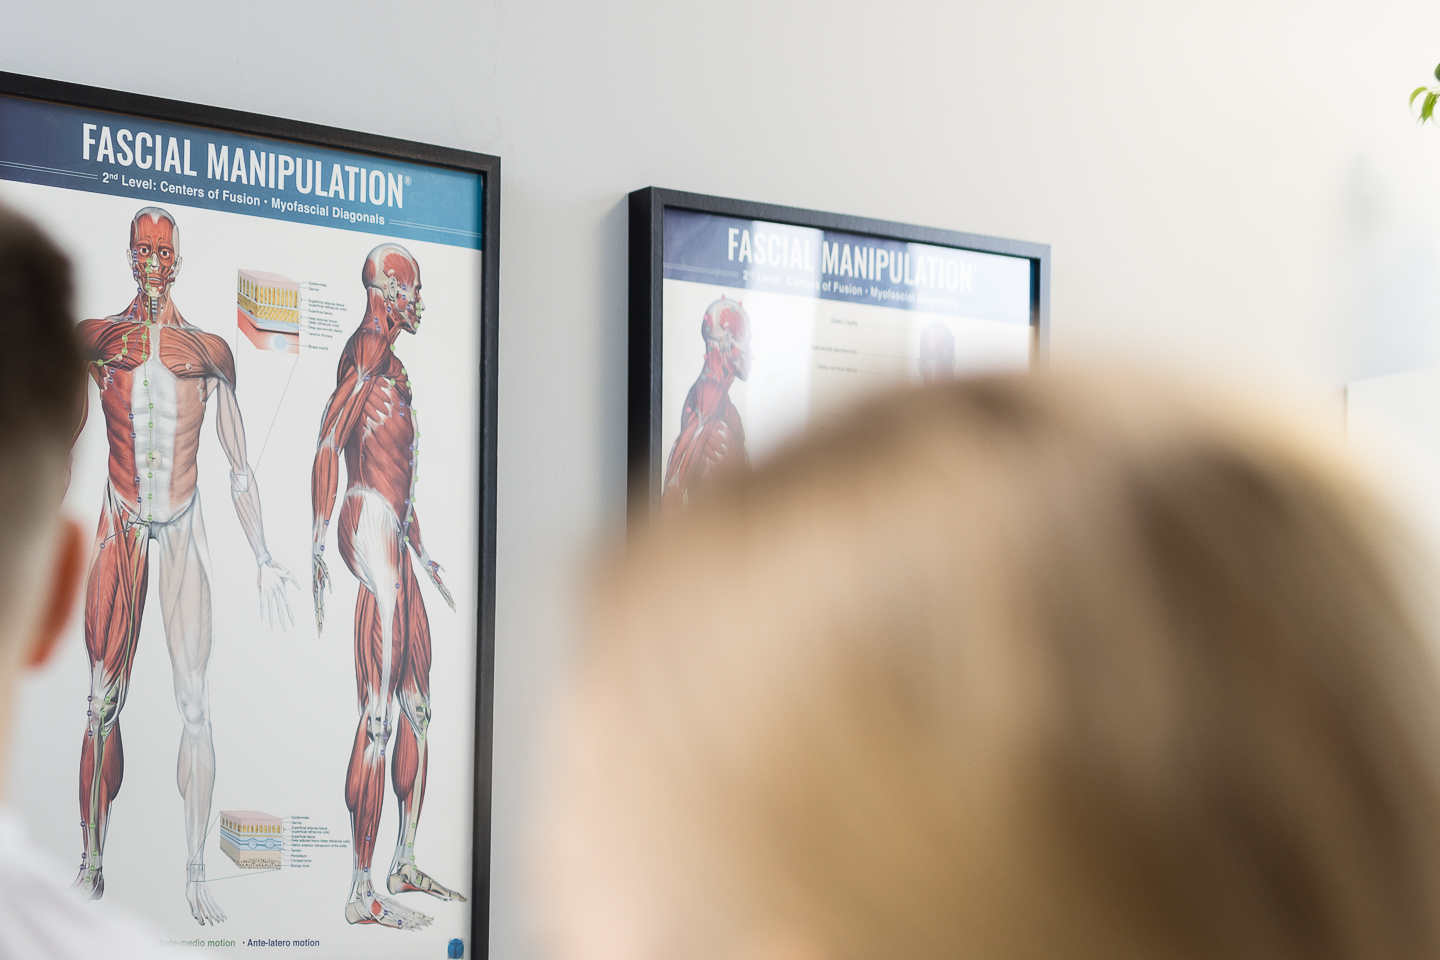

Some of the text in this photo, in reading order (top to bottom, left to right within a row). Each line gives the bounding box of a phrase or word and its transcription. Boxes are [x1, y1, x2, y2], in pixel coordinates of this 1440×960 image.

[83, 123, 197, 177] FASCIAL
[102, 172, 385, 225] 2nd Level: Centers of Fusion Myofascial Diagonals
[728, 227, 815, 272] FASCIAL
[822, 280, 831, 292] of
[833, 280, 863, 296] Fusion
[207, 939, 235, 947] motion
[247, 939, 319, 947] Ante-latero motion
